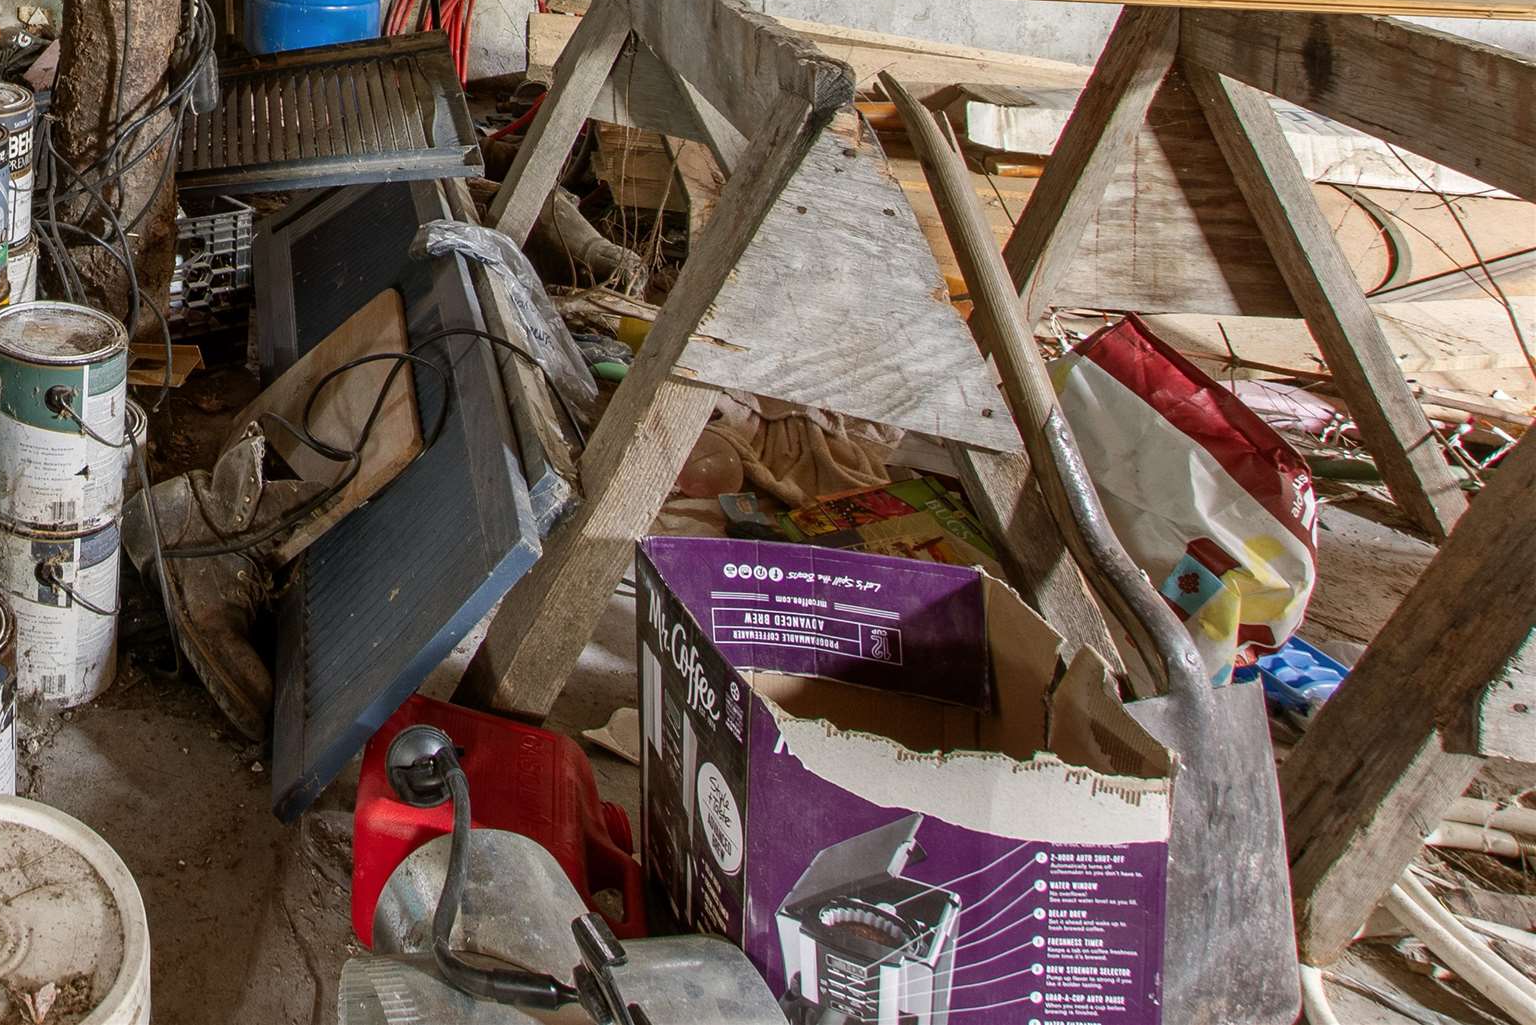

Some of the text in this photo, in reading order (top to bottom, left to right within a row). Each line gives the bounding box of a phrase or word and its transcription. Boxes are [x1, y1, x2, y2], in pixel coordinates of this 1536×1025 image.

[786, 571, 881, 593] Let's Spill the Beans
[775, 595, 828, 608] mrcoffee.com
[744, 612, 825, 631] ADVANCED BREW
[732, 630, 839, 650] PROGRAMMABLE COFFEEMAKER
[870, 634, 892, 661] 12
[648, 589, 671, 653] Mr.
[671, 623, 720, 721] Coffee
[709, 776, 730, 811] Style
[707, 812, 732, 857] ADVANCED
[1076, 853, 1093, 863] AUTO
[1094, 854, 1125, 864] SHUT-OFF
[1049, 881, 1098, 891] WATER WINDOW
[1048, 909, 1088, 919] DELAY BREW
[1047, 937, 1104, 947] FRESHNESS TIMER
[1046, 965, 1132, 977] BREW STRENGTH SELECTOR
[1045, 993, 1126, 1005] GRAB-A-CUP AUTO PAUSE
